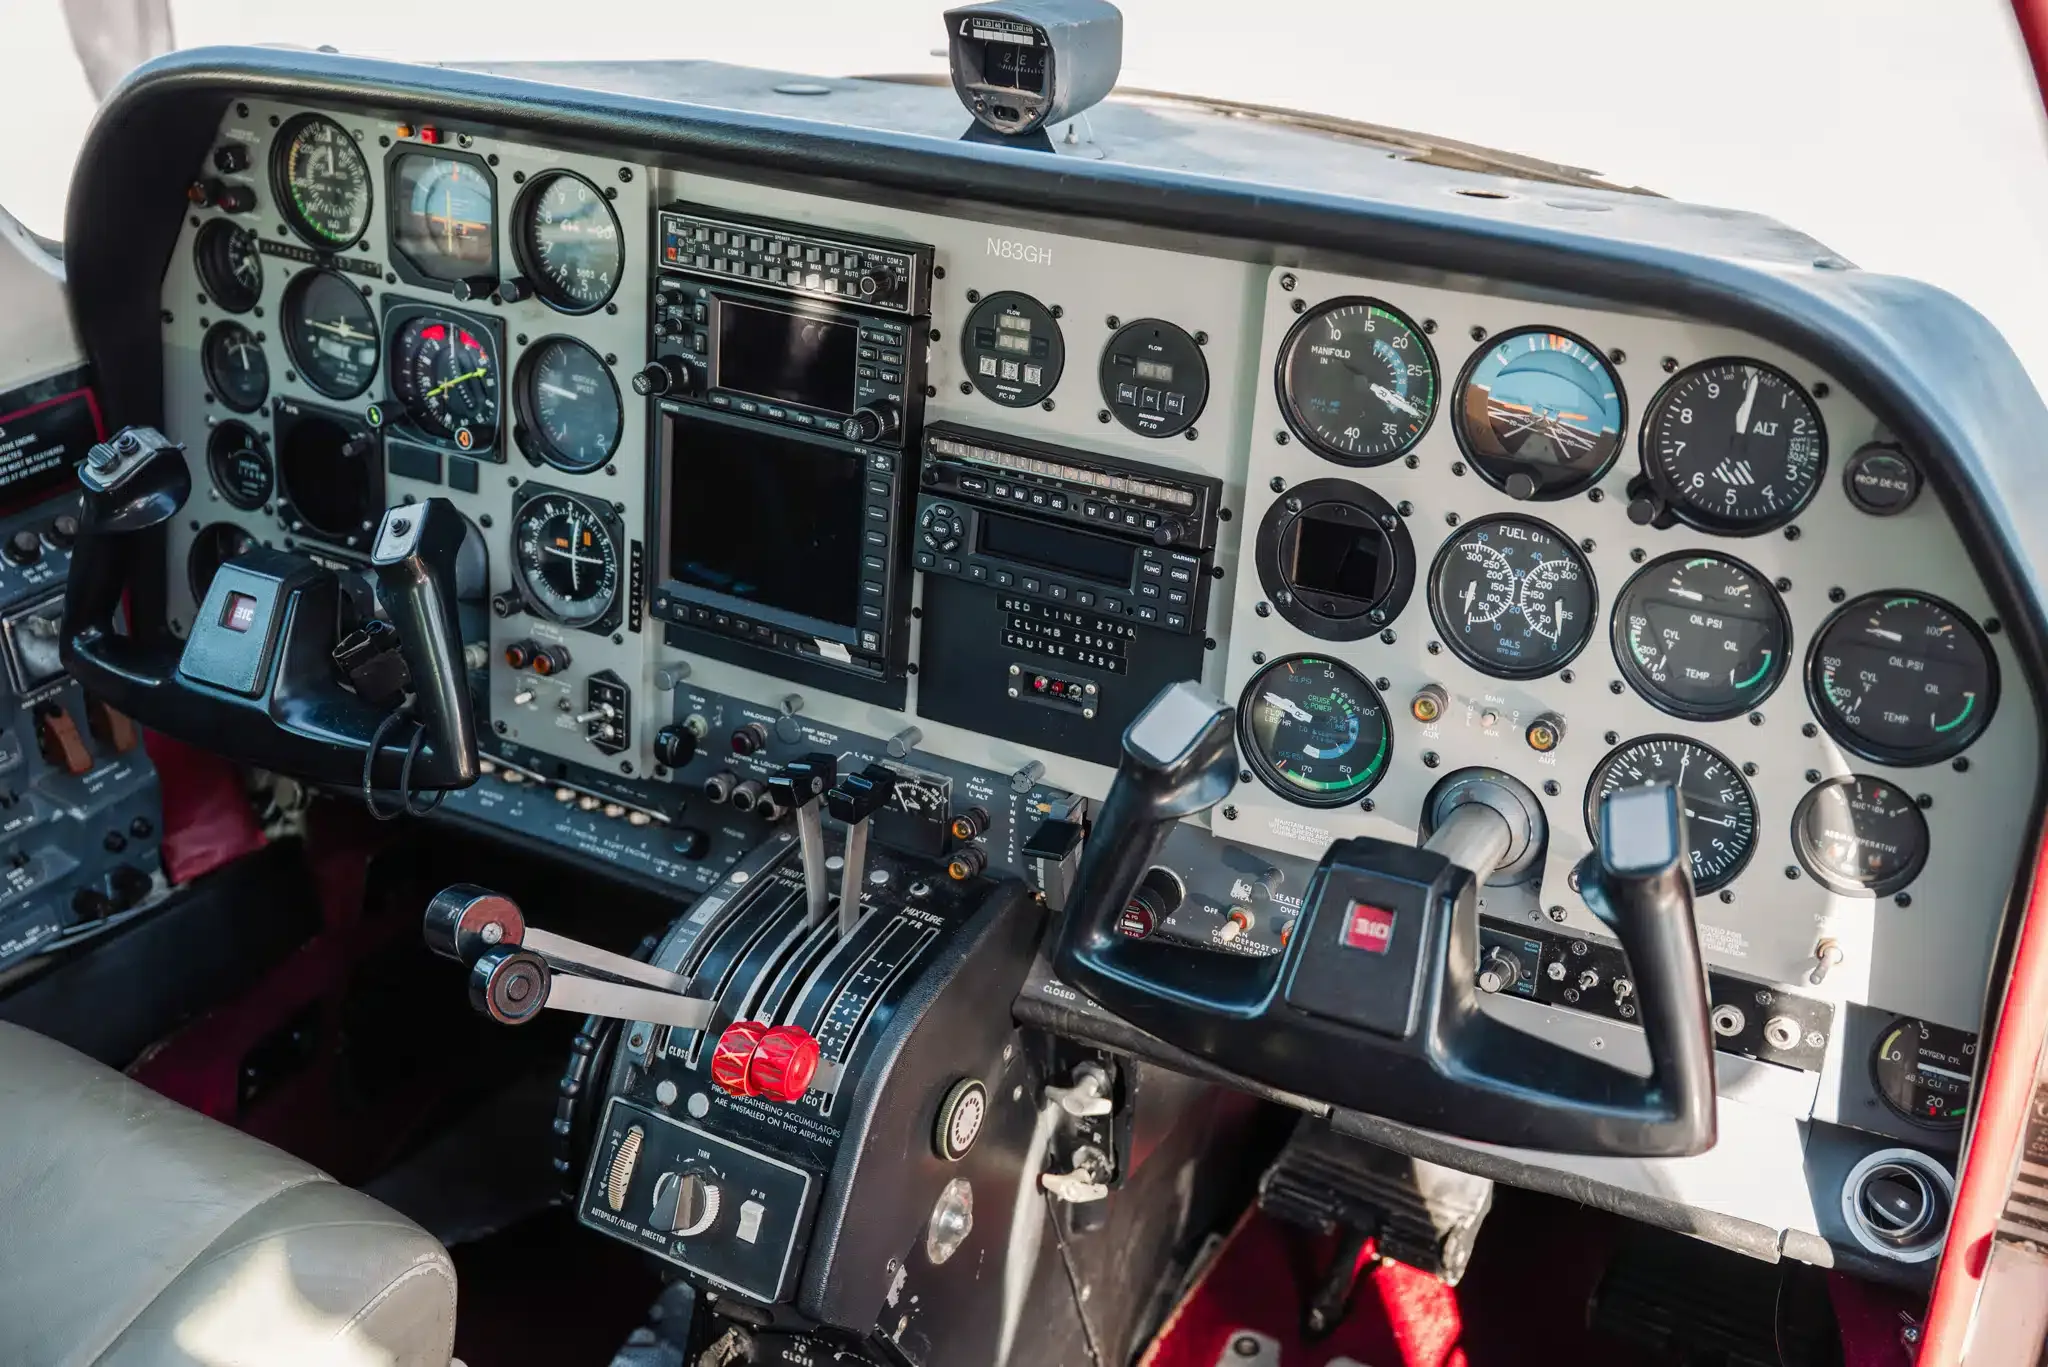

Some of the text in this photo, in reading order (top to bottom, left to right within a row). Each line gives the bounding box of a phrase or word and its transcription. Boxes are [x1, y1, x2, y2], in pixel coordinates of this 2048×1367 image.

[702, 243, 710, 251] TEL
[986, 237, 1052, 266] N83GH
[765, 255, 774, 263] NAV
[867, 253, 879, 261] COM
[887, 256, 899, 265] COM
[791, 260, 803, 268] DME
[810, 263, 822, 271] MKR
[845, 270, 859, 278] AUTO
[1364, 320, 1375, 332] 15
[1331, 329, 1341, 340] 10
[1392, 337, 1408, 349] 20
[1311, 345, 1351, 359] MANIFOLD
[882, 354, 897, 363] MENU
[1407, 365, 1423, 376] 25
[882, 373, 893, 381] ENT
[1707, 383, 1720, 399] 9
[1781, 393, 1787, 409] 1
[1680, 408, 1692, 424] 8
[1139, 421, 1157, 429] FT-10
[1382, 423, 1398, 435] 35
[1753, 421, 1779, 436] ALT
[1793, 418, 1806, 435] 2
[1344, 427, 1360, 438] 40
[1675, 441, 1686, 456] 7
[1785, 464, 1797, 481] 3
[1692, 472, 1704, 488] 6
[1015, 490, 1024, 499] NAV
[1724, 488, 1736, 505] 5
[1761, 485, 1774, 499] 4
[1034, 495, 1043, 504] SYS
[1127, 516, 1135, 524] SEL
[1477, 532, 1488, 541] 50
[1499, 525, 1527, 541] FUEL
[925, 536, 935, 546] OFF
[944, 542, 954, 550] VFR
[1172, 554, 1196, 563] GARMIN
[1466, 552, 1483, 563] 300
[1531, 552, 1542, 561] 40
[1144, 565, 1160, 573] FUNC
[1483, 560, 1500, 570] 250
[1171, 571, 1187, 580] CRSR
[1486, 570, 1503, 580] 200
[1514, 569, 1525, 577] 30
[1542, 572, 1559, 582] 250
[1561, 571, 1577, 580] 300
[632, 551, 640, 626] ACTIVATE
[1536, 580, 1552, 590] 200
[1143, 587, 1155, 595] CLR
[1724, 586, 1739, 596] 100
[1487, 594, 1500, 602] 100
[1478, 602, 1489, 612] 50
[1509, 605, 1521, 614] 20
[1532, 603, 1546, 612] 100
[1005, 600, 1133, 636] RED LINE 2700
[1540, 615, 1551, 625] 50
[1630, 616, 1647, 626] 500
[1690, 615, 1722, 629] OIL PSI
[1014, 619, 1113, 650] CLIMB 2500
[1663, 628, 1680, 640] CYL
[1926, 626, 1942, 636] 100
[1641, 646, 1657, 654] 300
[1724, 640, 1739, 651] OIL
[1007, 634, 1115, 669] CRUISE 2250
[1823, 656, 1841, 667] 500
[1889, 656, 1924, 671] OIL PSI
[1324, 671, 1334, 679] 50
[1652, 672, 1666, 681] 100
[1685, 668, 1710, 680] TEMP
[1860, 671, 1878, 682] CYL
[1925, 683, 1940, 694] OIL
[1308, 695, 1330, 704] CRUISE
[1485, 694, 1504, 705] MAIN
[1310, 703, 1332, 712] POWER
[1362, 708, 1375, 716] 100
[743, 710, 776, 723] UNLOCKED
[1265, 709, 1285, 718] FLOW
[1883, 711, 1909, 723] TEMP
[1846, 715, 1860, 724] 100
[808, 734, 832, 745] SELECT
[817, 730, 838, 741] METER
[1422, 729, 1440, 739] AUX
[1538, 756, 1556, 765] AUX
[1652, 754, 1663, 766] 3
[1301, 765, 1312, 773] 170
[1704, 766, 1718, 779] E
[966, 783, 994, 795] FAILURE
[1852, 801, 1884, 815] SUCTION
[1712, 838, 1724, 851] S
[903, 906, 945, 926] MIXTURE
[1204, 906, 1218, 915] OFF
[1234, 937, 1269, 952] DEFROST
[1043, 985, 1076, 1000] CLOSED
[1920, 1029, 1929, 1039] 5
[1919, 1048, 1960, 1065] OXYGEN CYL
[1928, 1079, 1942, 1088] CU
[1949, 1084, 1959, 1092] FT
[802, 1094, 818, 1106] ICO
[1926, 1095, 1944, 1107] 20
[715, 1097, 833, 1147] ARE INSTALLED ON THIS AIRPLANE
[784, 1112, 841, 1138] ACCUMULATORS
[591, 1207, 666, 1244] AUTOPILOT/FLIGHT DIRECTOR
